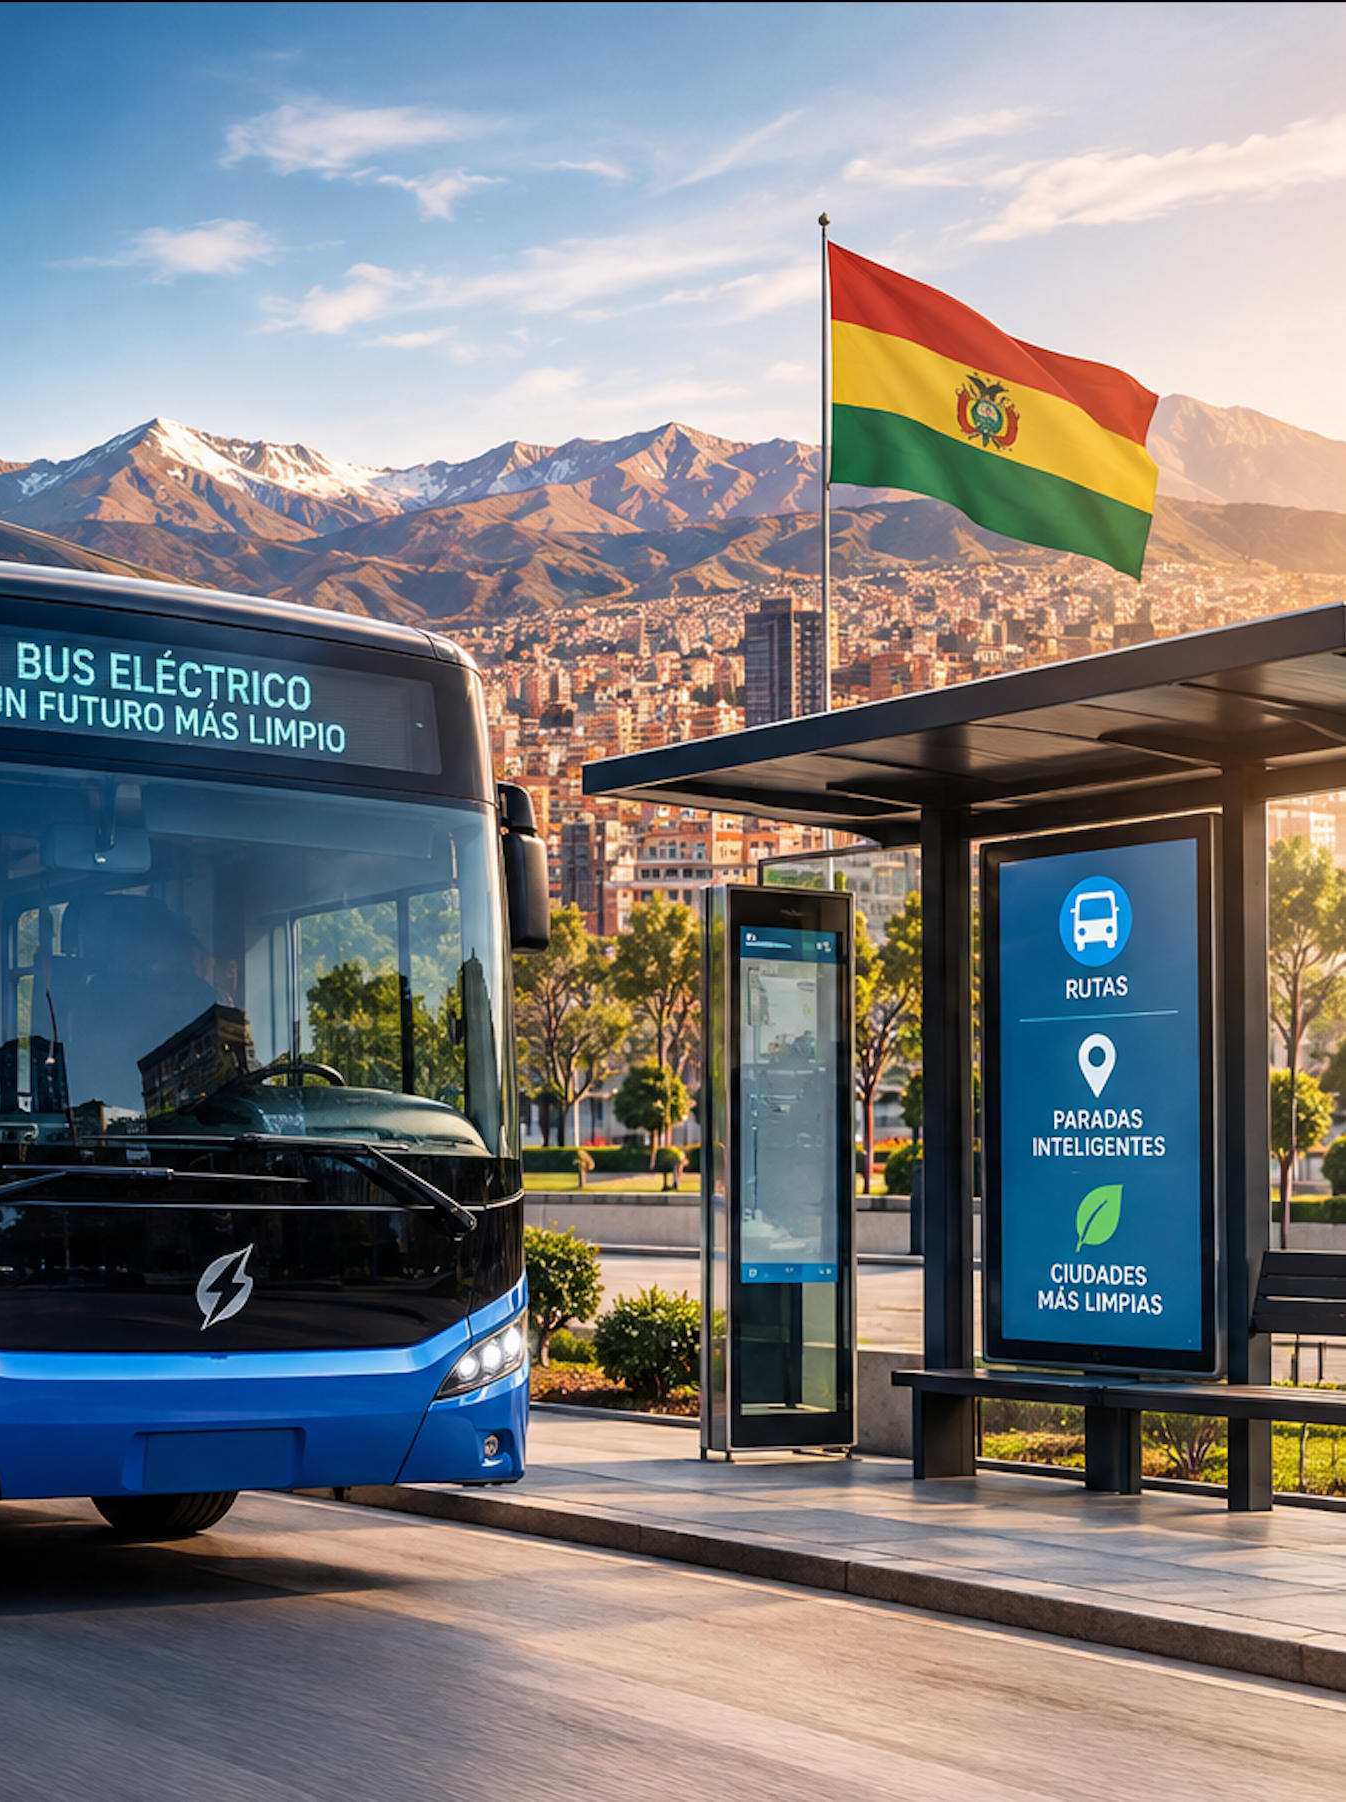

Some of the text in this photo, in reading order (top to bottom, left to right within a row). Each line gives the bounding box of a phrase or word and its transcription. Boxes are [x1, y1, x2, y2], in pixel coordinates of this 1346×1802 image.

[17, 641, 311, 712] BUS ELÉCTRICO
[39, 690, 164, 732] FUTURO
[175, 702, 239, 741] MÁS
[249, 716, 346, 754] LIMPIO
[1065, 975, 1128, 999] RUTAS
[1053, 1109, 1143, 1130] PARADAS
[1032, 1136, 1166, 1157] INTELIGENTES
[1050, 1263, 1147, 1286] CIUDADES
[1038, 1286, 1163, 1315] MÁS LIMPIAS
